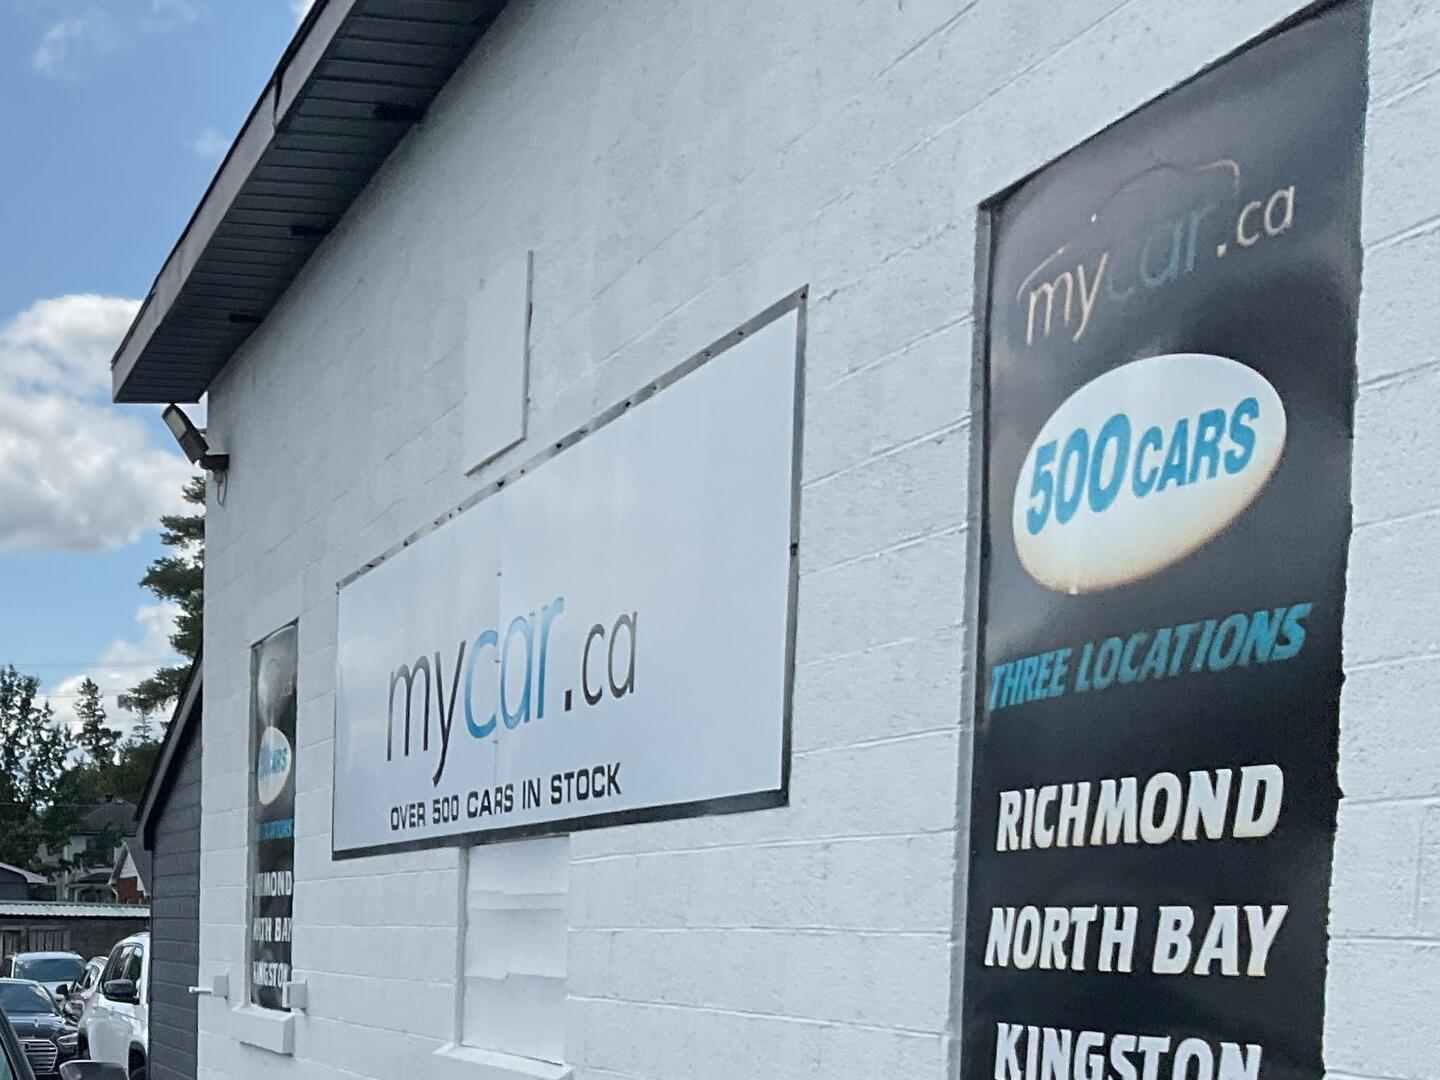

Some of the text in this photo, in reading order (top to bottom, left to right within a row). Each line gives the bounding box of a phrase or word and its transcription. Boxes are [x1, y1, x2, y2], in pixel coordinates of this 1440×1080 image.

[386, 596, 638, 787] mycar.ca
[988, 602, 1312, 710] THREE LOCATIONS
[390, 762, 622, 831] OVER 500 CARS IN STOCK
[996, 764, 1284, 852] RICHMOND
[984, 904, 1288, 977] NORTH BAY
